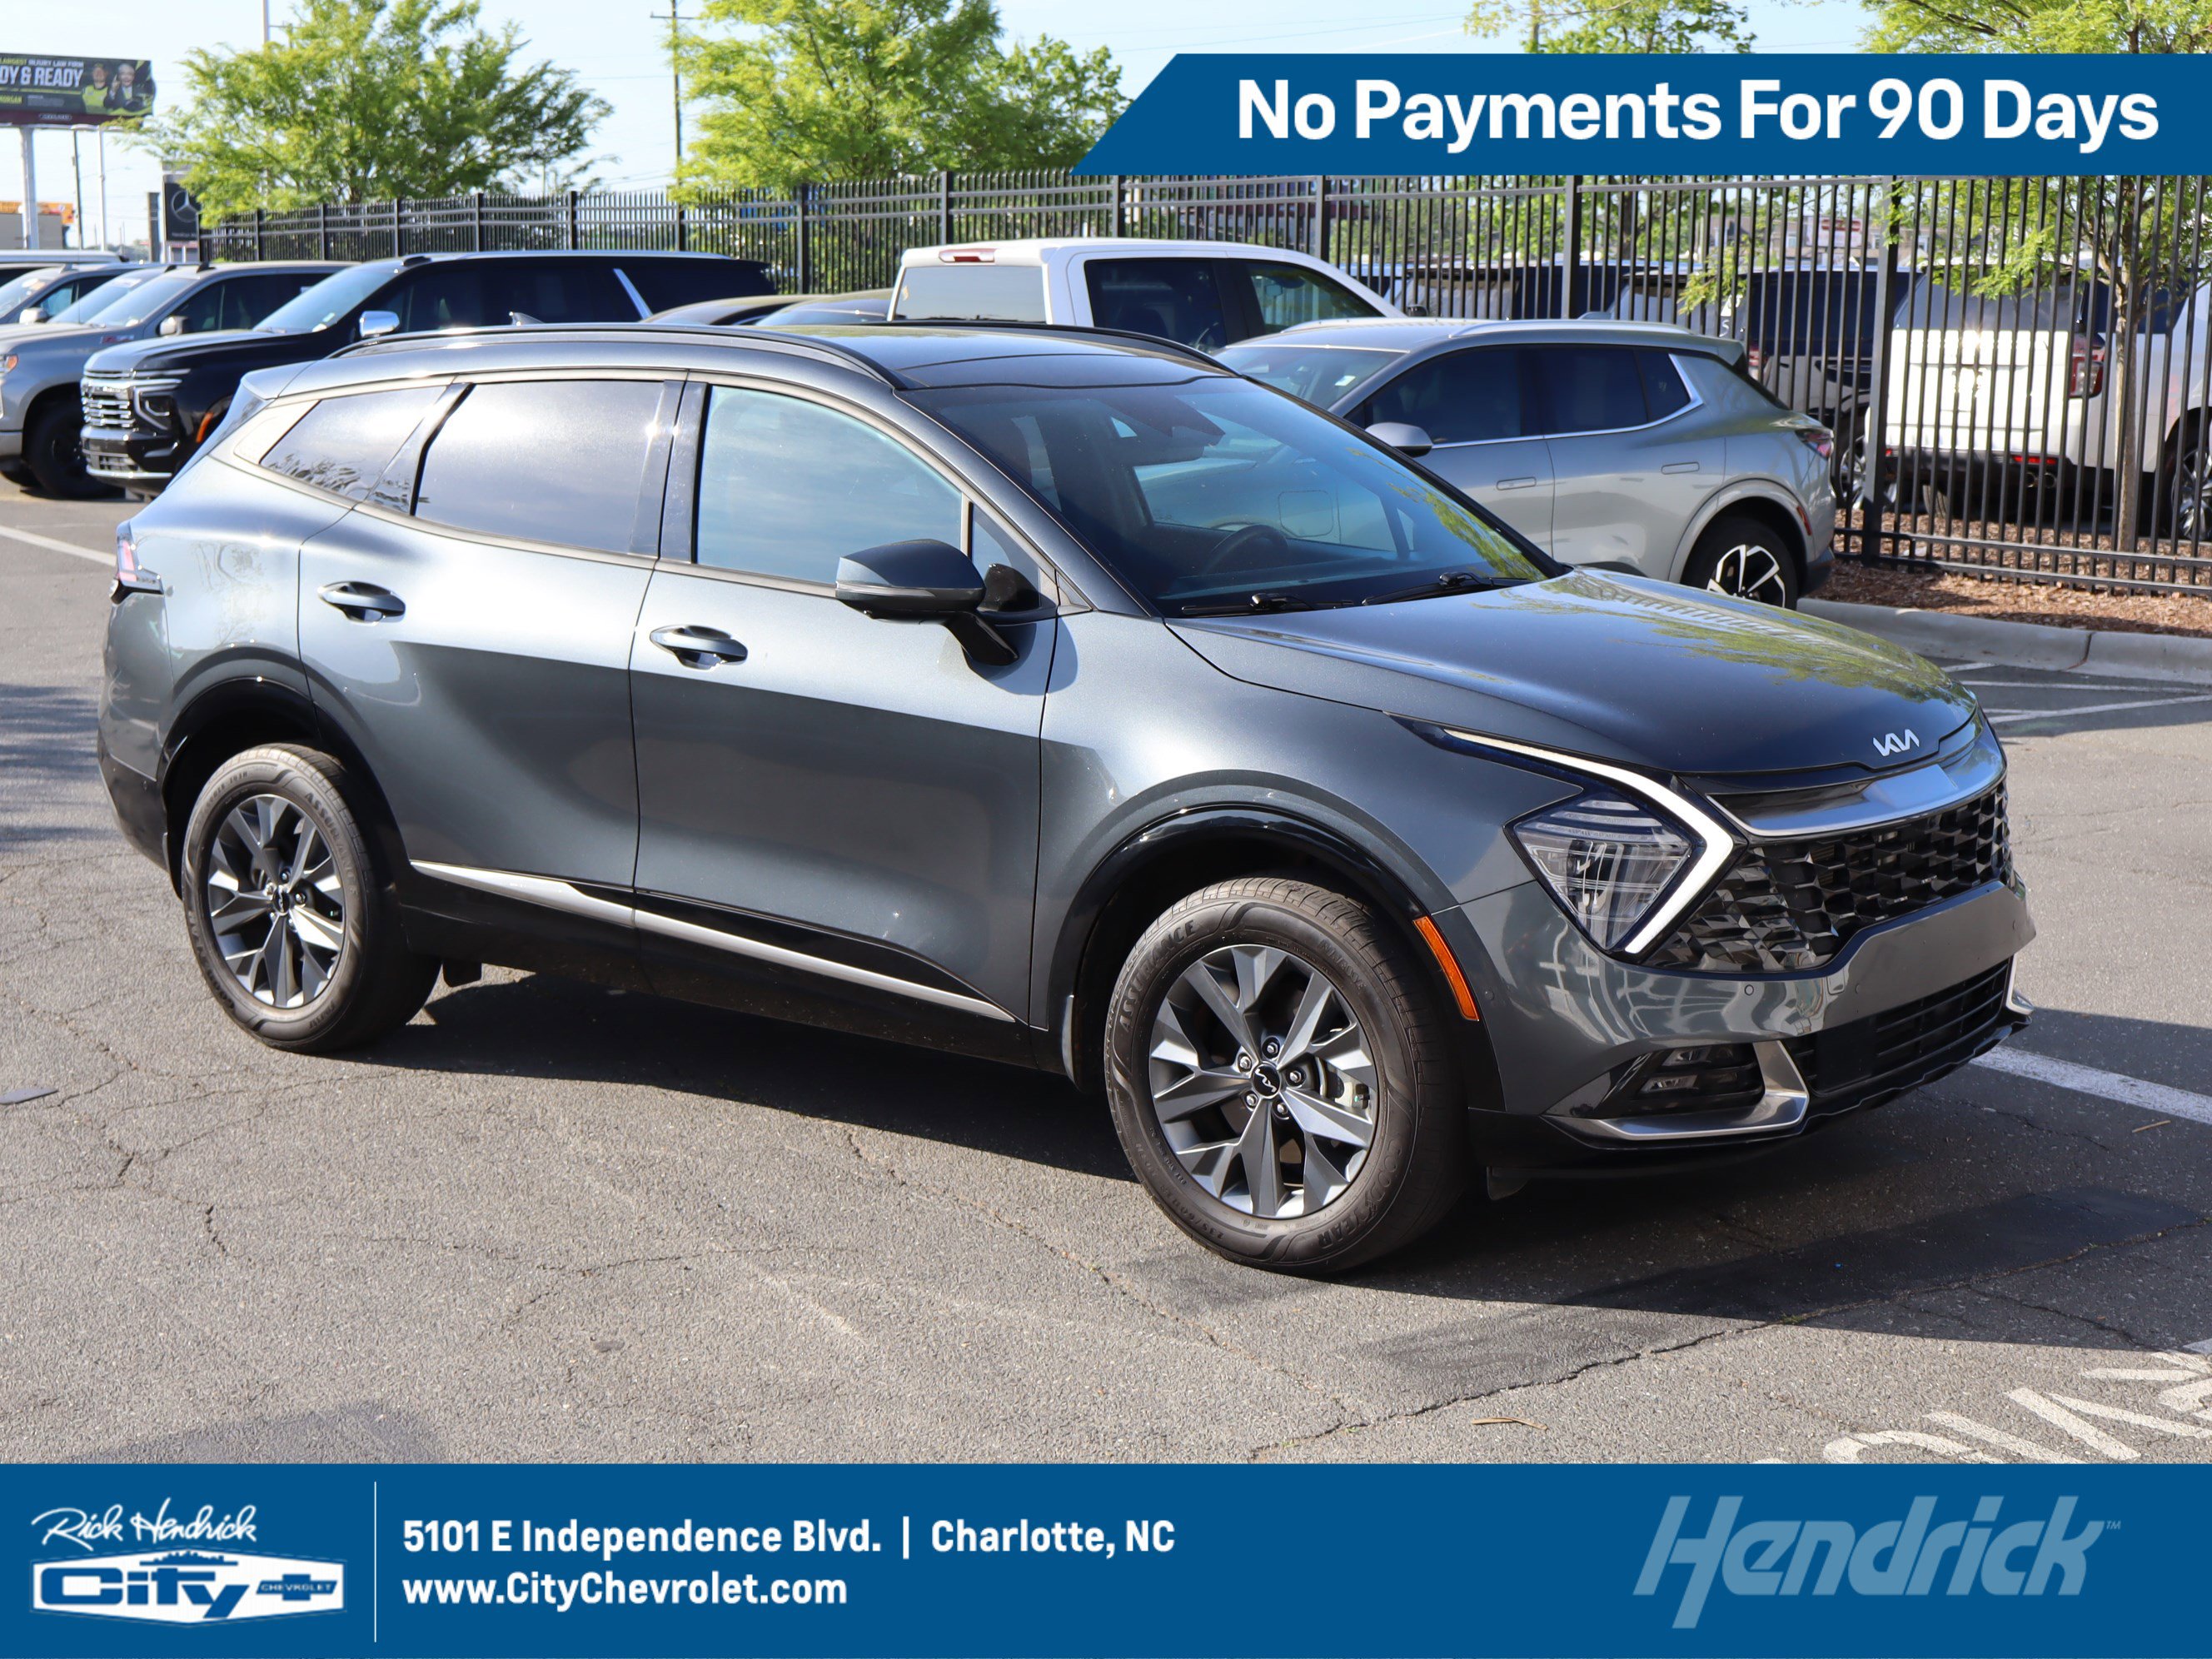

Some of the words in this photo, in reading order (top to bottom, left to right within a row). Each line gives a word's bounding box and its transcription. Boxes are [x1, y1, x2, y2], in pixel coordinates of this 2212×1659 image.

[21, 67, 32, 85] &
[34, 67, 83, 87] READY
[1117, 918, 1198, 1034] ASSURANCE
[1317, 1136, 1402, 1251] GOODYEAR
